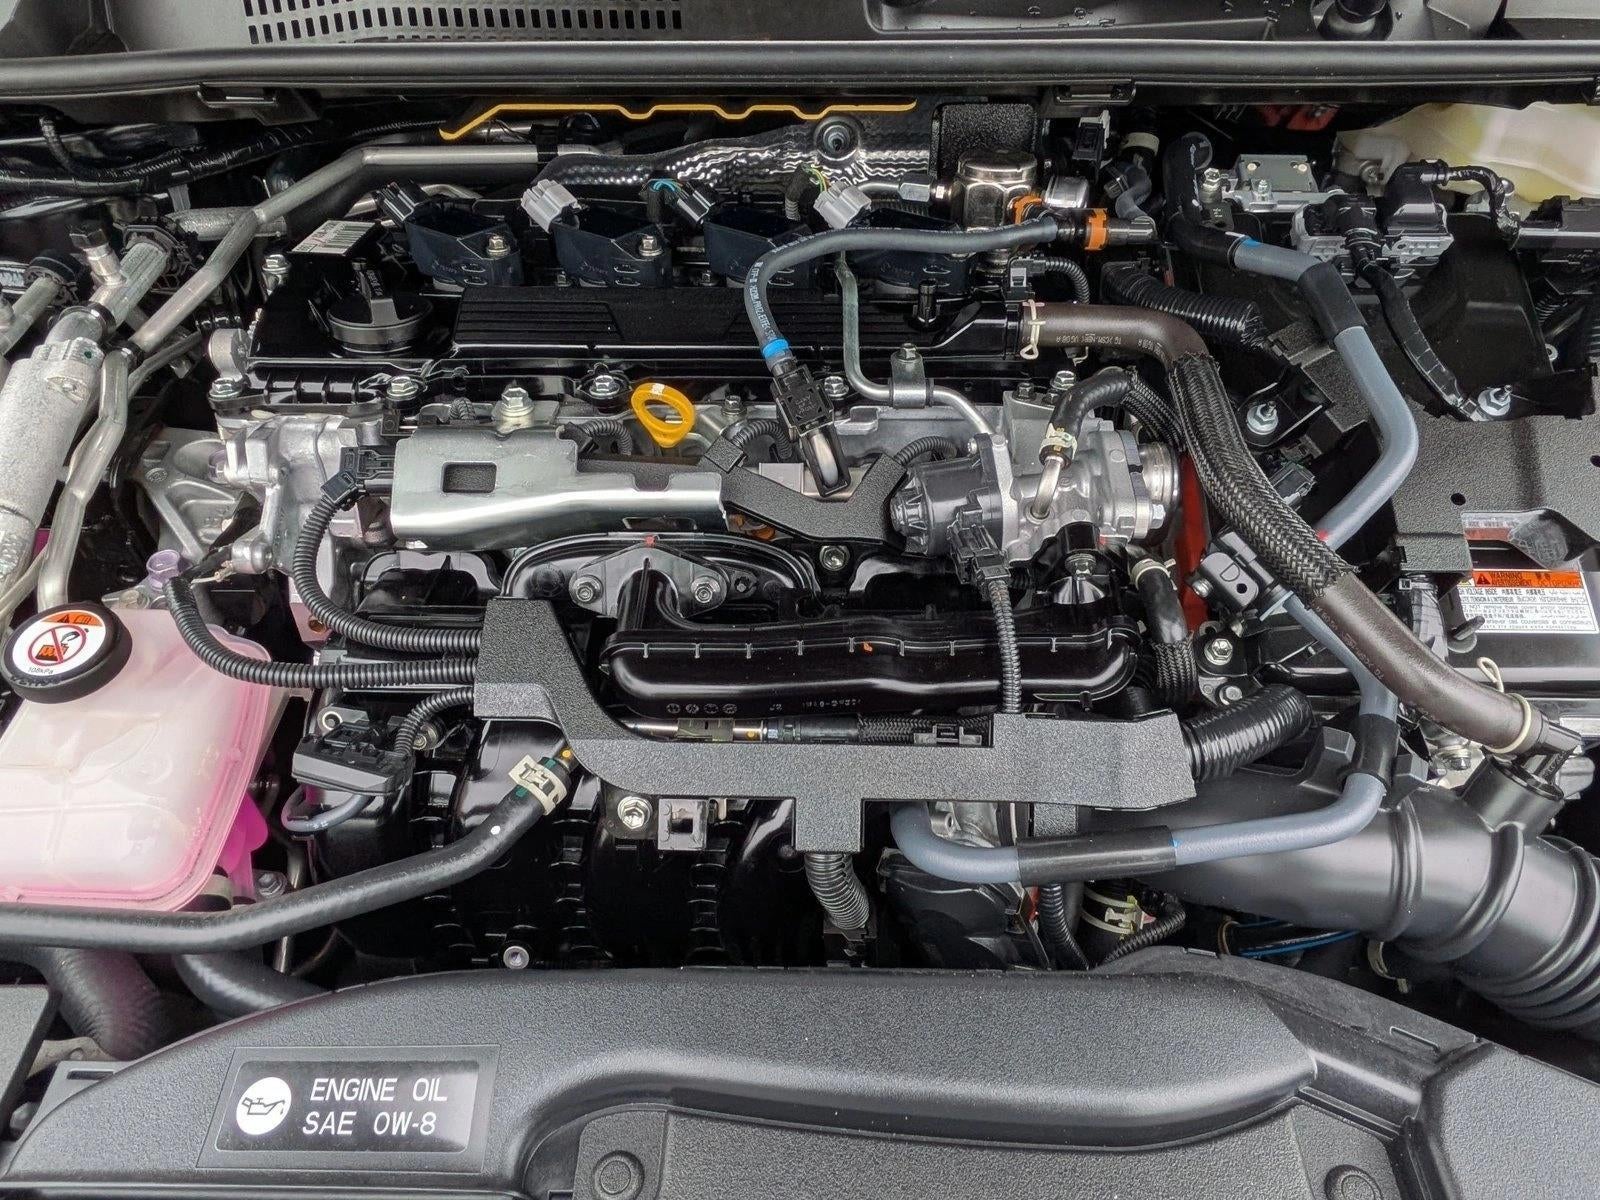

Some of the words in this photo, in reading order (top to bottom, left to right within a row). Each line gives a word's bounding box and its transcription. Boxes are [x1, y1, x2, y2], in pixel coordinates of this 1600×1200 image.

[309, 1077, 398, 1102] ENGINE
[412, 1077, 448, 1102] OIL
[302, 1111, 357, 1135] SAE
[373, 1111, 437, 1136] 0W-8
